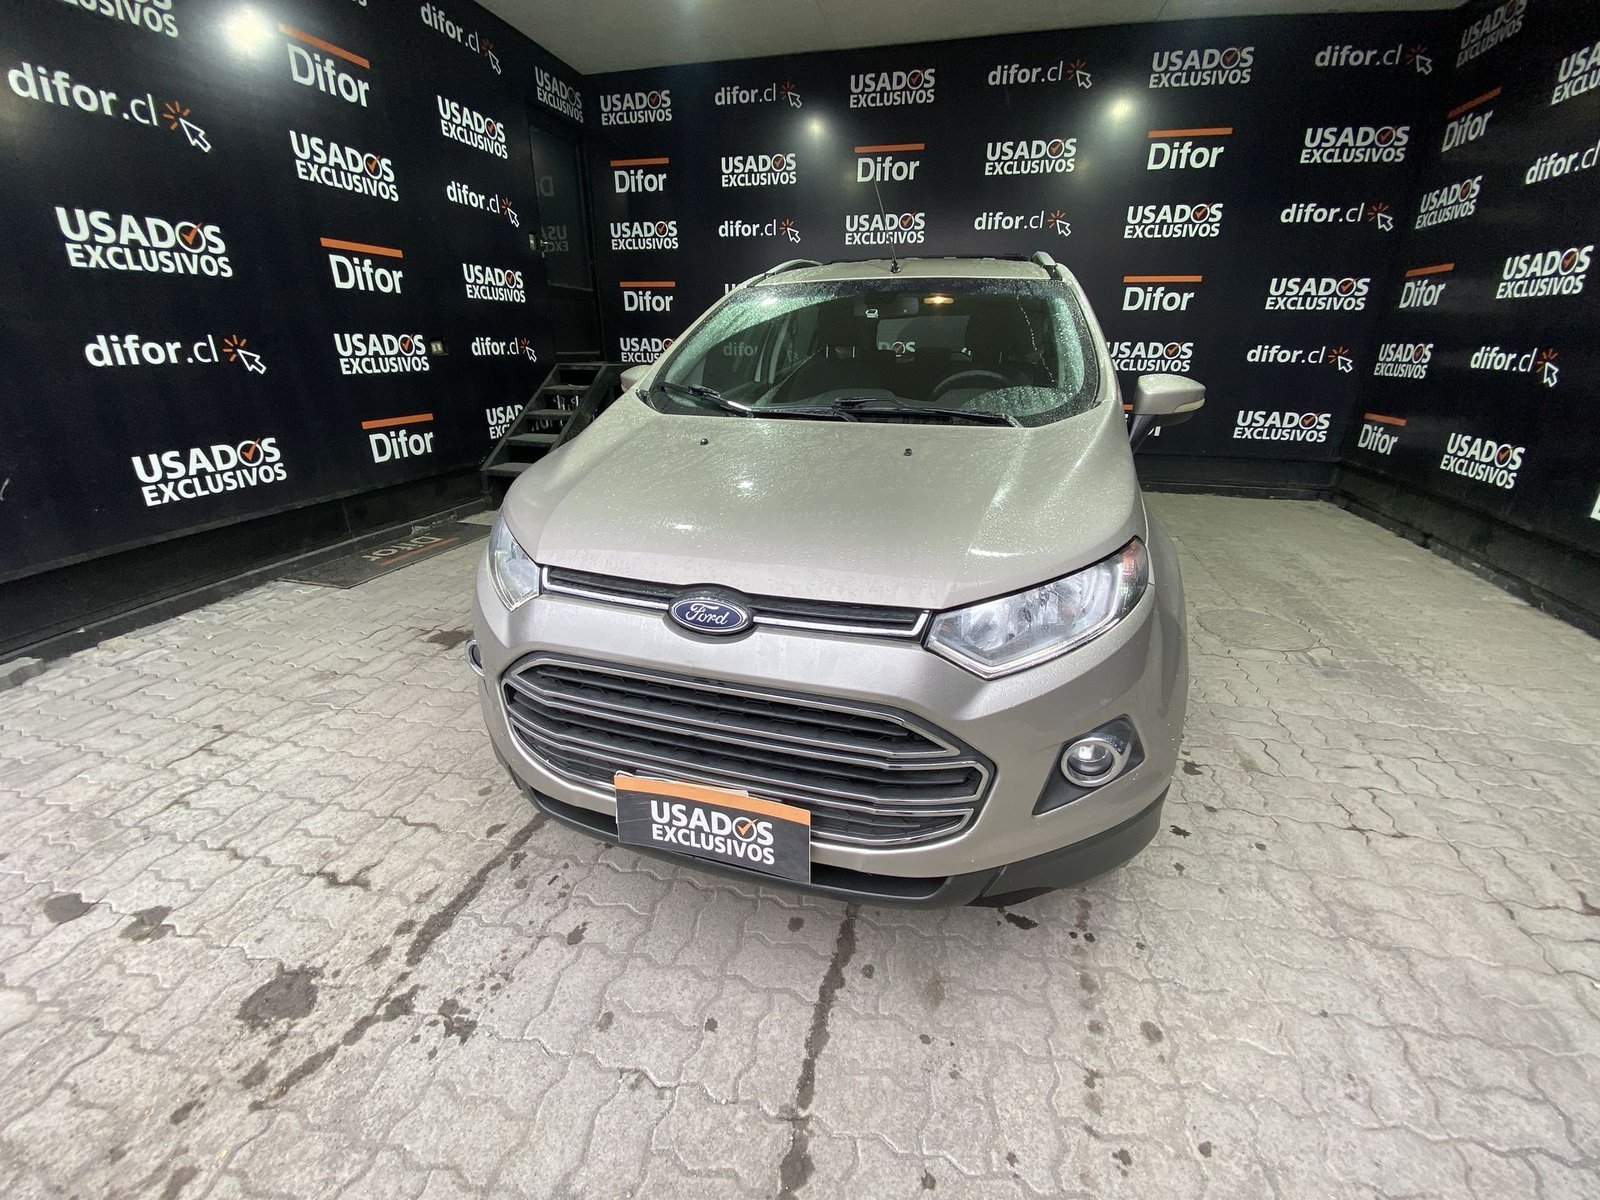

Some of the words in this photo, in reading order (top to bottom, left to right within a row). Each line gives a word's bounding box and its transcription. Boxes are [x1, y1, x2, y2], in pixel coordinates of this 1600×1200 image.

[420, 2, 480, 54] difor.cl
[1461, 0, 1528, 50] USADOS
[1456, 14, 1525, 68] EXCLUSIVOS
[1152, 46, 1254, 72] USADOS
[1315, 44, 1402, 66] difor.cl
[287, 43, 370, 107] Difor
[850, 68, 935, 93] USADOS
[987, 61, 1064, 86] difor.cl
[1149, 68, 1251, 88] EXCLUSIVOS
[8, 61, 159, 127] difor.cl
[534, 66, 582, 106] USADOS
[714, 83, 776, 105] difor.cl
[536, 86, 584, 124] EXCLUSIVOS
[600, 90, 671, 112] USADOS
[849, 89, 935, 108] EXCLUSIVOS
[437, 95, 506, 143] USADOS
[601, 108, 672, 126] EXCLUSIVOS
[441, 119, 508, 160] EXCLUSIVOS
[1304, 126, 1410, 147] USADOS
[1441, 110, 1494, 152] Difor
[289, 130, 395, 183] USADOS
[986, 138, 1077, 161] USADOS
[1147, 141, 1224, 170] Difor
[1299, 147, 1405, 164] EXCLUSIVOS
[721, 153, 796, 173] USADOS
[857, 156, 920, 183] Difor
[984, 158, 1075, 176] EXCLUSIVOS
[295, 159, 399, 202] EXCLUSIVOS
[614, 169, 667, 193] Difor
[721, 171, 797, 187] EXCLUSIVOS
[446, 181, 500, 214] difor.cl
[1420, 175, 1483, 213] USADOS
[845, 213, 926, 231] USADOS
[974, 211, 1044, 230] difor.cl
[1127, 203, 1223, 224] USADOS
[1280, 203, 1364, 223] difor.cl
[1415, 199, 1476, 229] EXCLUSIVOS
[55, 206, 226, 255] USADOS
[610, 221, 677, 238] USADOS
[718, 219, 777, 237] difor.cl
[845, 230, 925, 245] EXCLUSIVOS
[1124, 223, 1220, 239] EXCLUSIVOS
[611, 237, 679, 250] EXCLUSIVOS
[65, 242, 233, 278] EXCLUSIVOS
[1503, 245, 1594, 280] USADOS
[329, 254, 403, 293] Difor
[462, 263, 524, 289] USADOS
[466, 284, 526, 303] EXCLUSIVOS
[1122, 286, 1195, 311] Difor
[1269, 277, 1371, 297] USADOS
[1399, 279, 1446, 309] Difor
[1496, 275, 1586, 299] EXCLUSIVOS
[623, 291, 673, 312] Difor
[1265, 297, 1366, 310] EXCLUSIVOS
[85, 334, 220, 367] difor.cl
[334, 333, 426, 356] USADOS
[471, 337, 519, 356] difor.cl
[619, 337, 674, 352] USADO
[1106, 341, 1194, 359] USADOS
[1247, 345, 1326, 363] difor.cl
[1378, 343, 1434, 364] USADOS
[339, 356, 430, 375] EXCLUSIVOS
[621, 352, 661, 363] EXCLUS
[1113, 359, 1191, 372] XCLUSIVOS
[1470, 347, 1538, 372] difor.cl
[1374, 362, 1427, 379] EXCLUSIVOS
[486, 404, 524, 426] USAD
[1236, 410, 1331, 429] USADOS
[368, 429, 434, 463] Difor
[1233, 427, 1327, 442] EXCLUSIVOS
[1358, 424, 1398, 455] Difor
[131, 437, 281, 483] USADOS
[1446, 433, 1525, 471] USADOS
[1440, 455, 1517, 489] EXCLUSIVOS
[141, 462, 287, 507] EXCLUSIVOS
[685, 602, 730, 626] Ford
[650, 800, 774, 846] USADOS
[652, 823, 775, 865] EXCLUSIVOS
